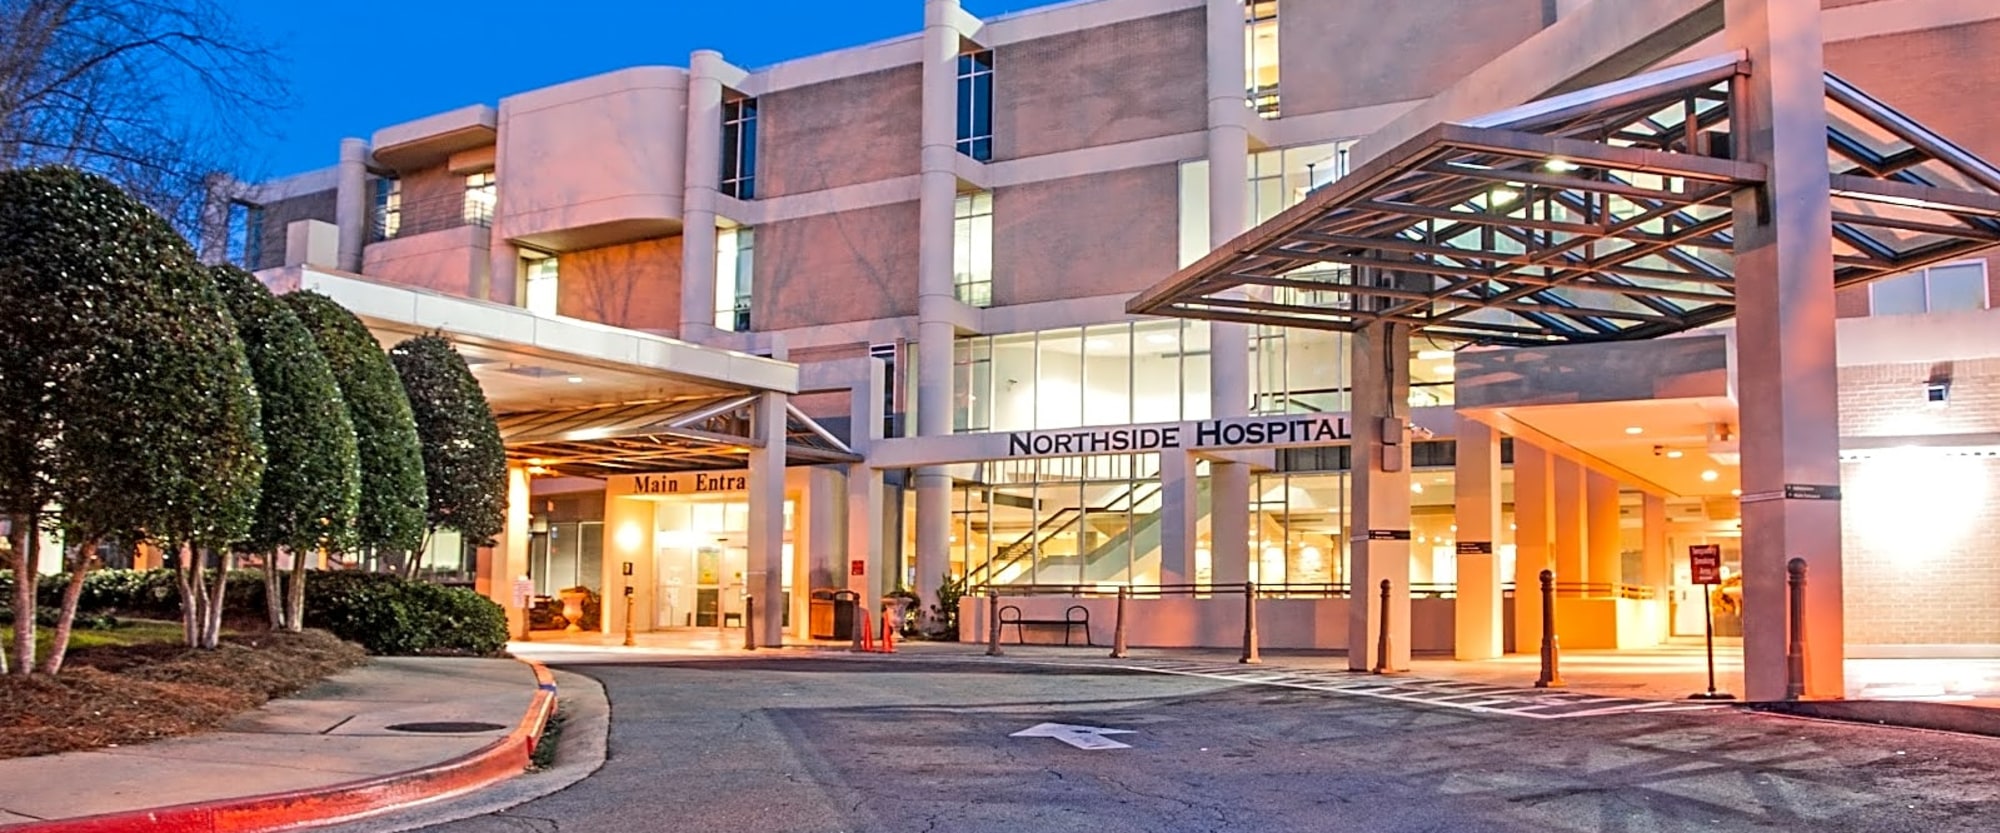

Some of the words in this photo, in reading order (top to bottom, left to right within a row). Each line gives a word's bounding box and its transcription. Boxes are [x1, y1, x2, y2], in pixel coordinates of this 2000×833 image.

[1009, 427, 1180, 456] NORTHSIDE
[1196, 418, 1351, 446] HOSPITAL
[634, 475, 678, 494] Main
